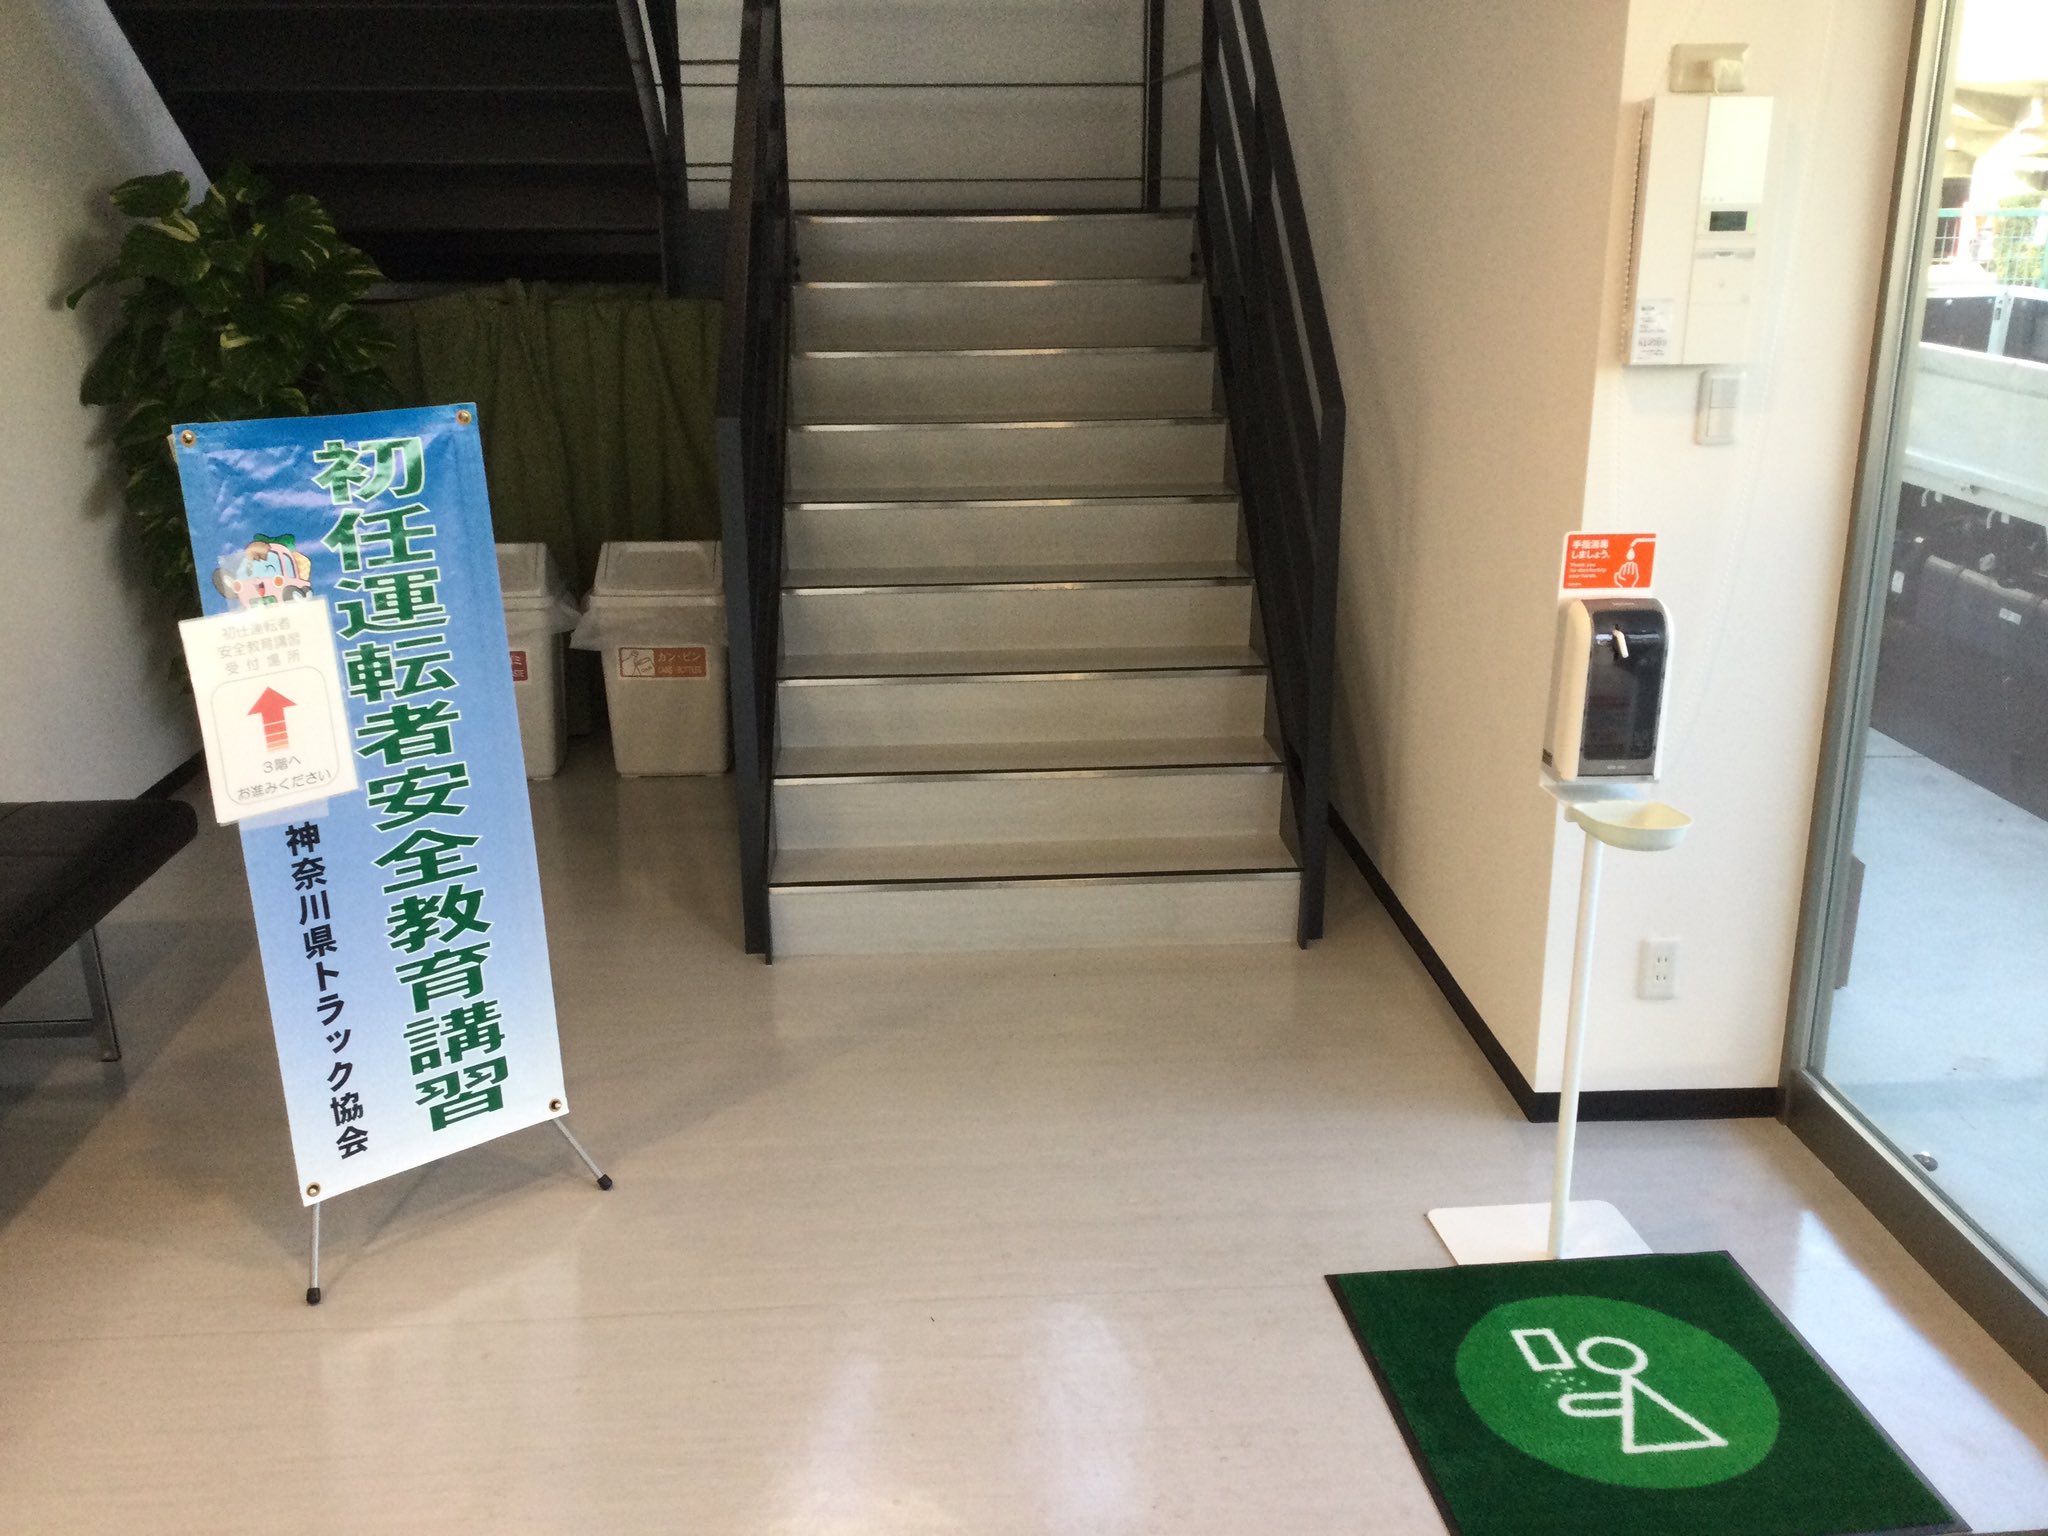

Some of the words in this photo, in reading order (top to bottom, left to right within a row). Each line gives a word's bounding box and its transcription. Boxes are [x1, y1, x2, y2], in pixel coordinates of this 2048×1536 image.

[285, 821, 369, 1160] 神奈川県トラック協会
[312, 437, 508, 1132] 初任運転者安全教育講習
